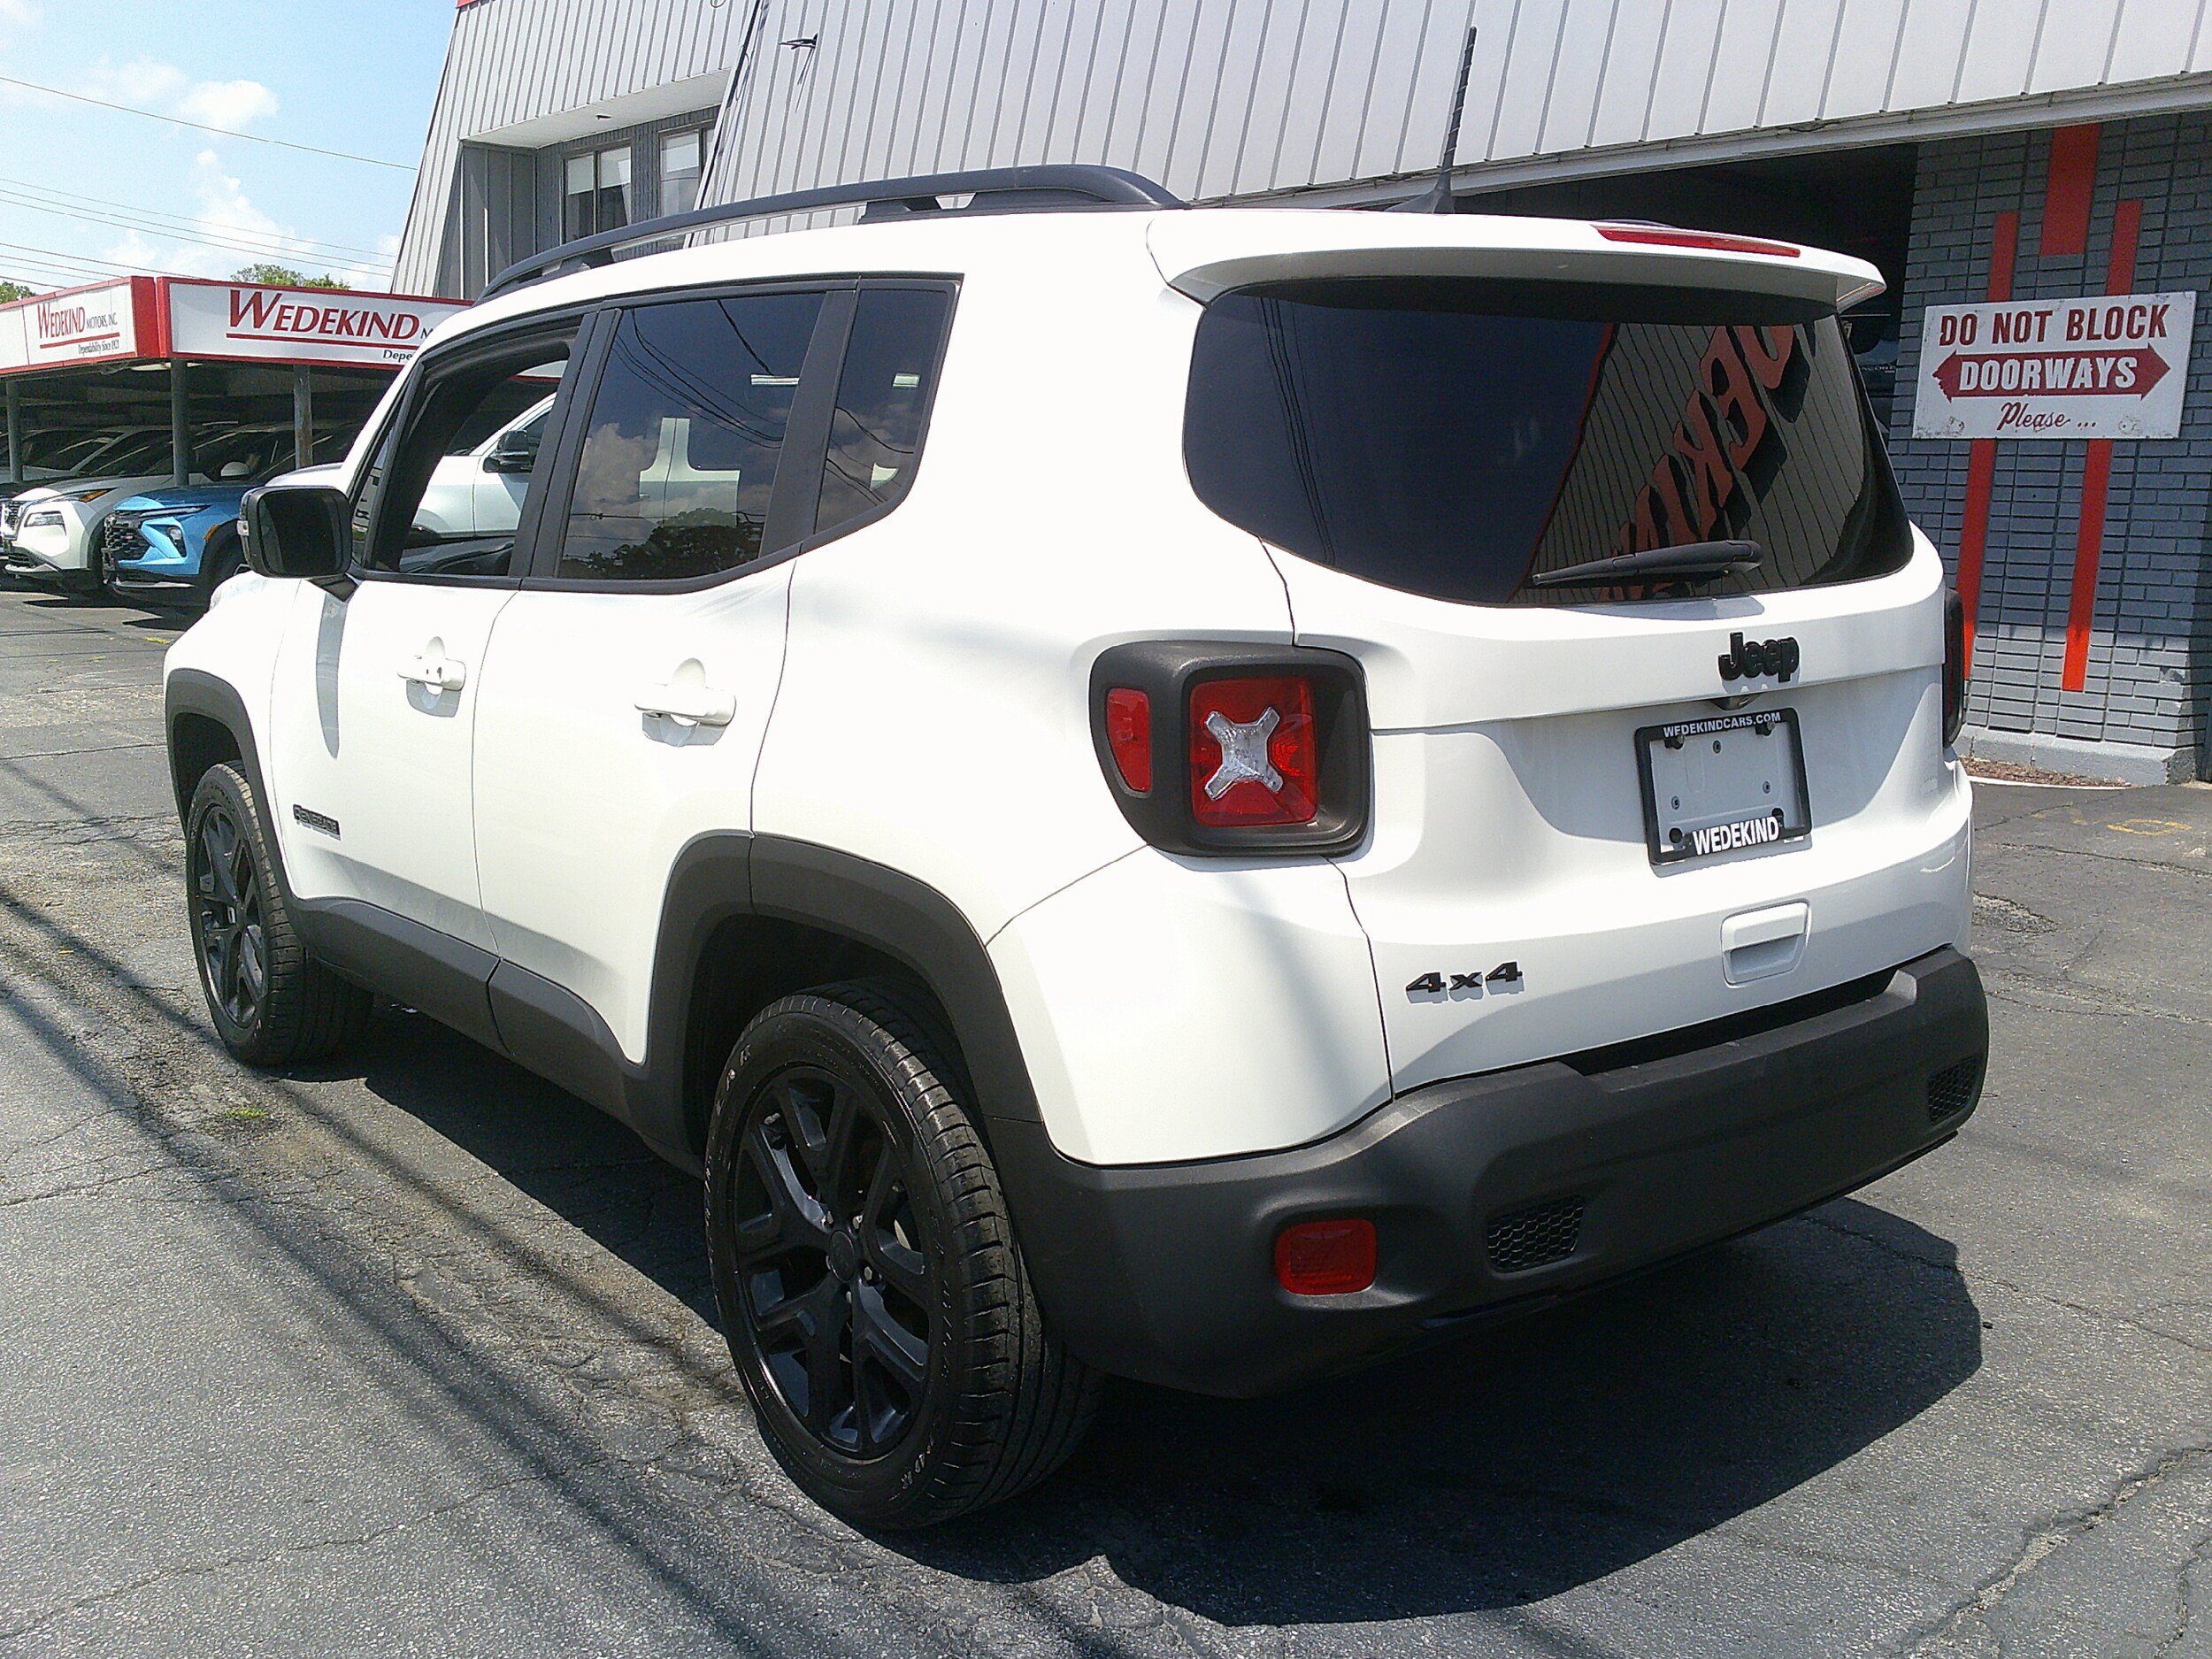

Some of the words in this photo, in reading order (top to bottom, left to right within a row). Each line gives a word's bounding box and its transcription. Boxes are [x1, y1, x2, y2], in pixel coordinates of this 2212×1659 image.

[37, 302, 86, 338] WEDEKIND
[229, 289, 420, 340] WEDEKIND
[1939, 313, 1978, 346] DO
[1992, 311, 2053, 344] NOT
[2066, 304, 2170, 342] BLOCK
[383, 349, 413, 363] Depe
[1958, 357, 2138, 391] DOORWAYS
[1996, 402, 2071, 431] Please
[1718, 632, 1800, 683] Jeep
[1663, 712, 1781, 738] WEDEKINDCARS.COM
[1693, 816, 1779, 856] WEDEKIND
